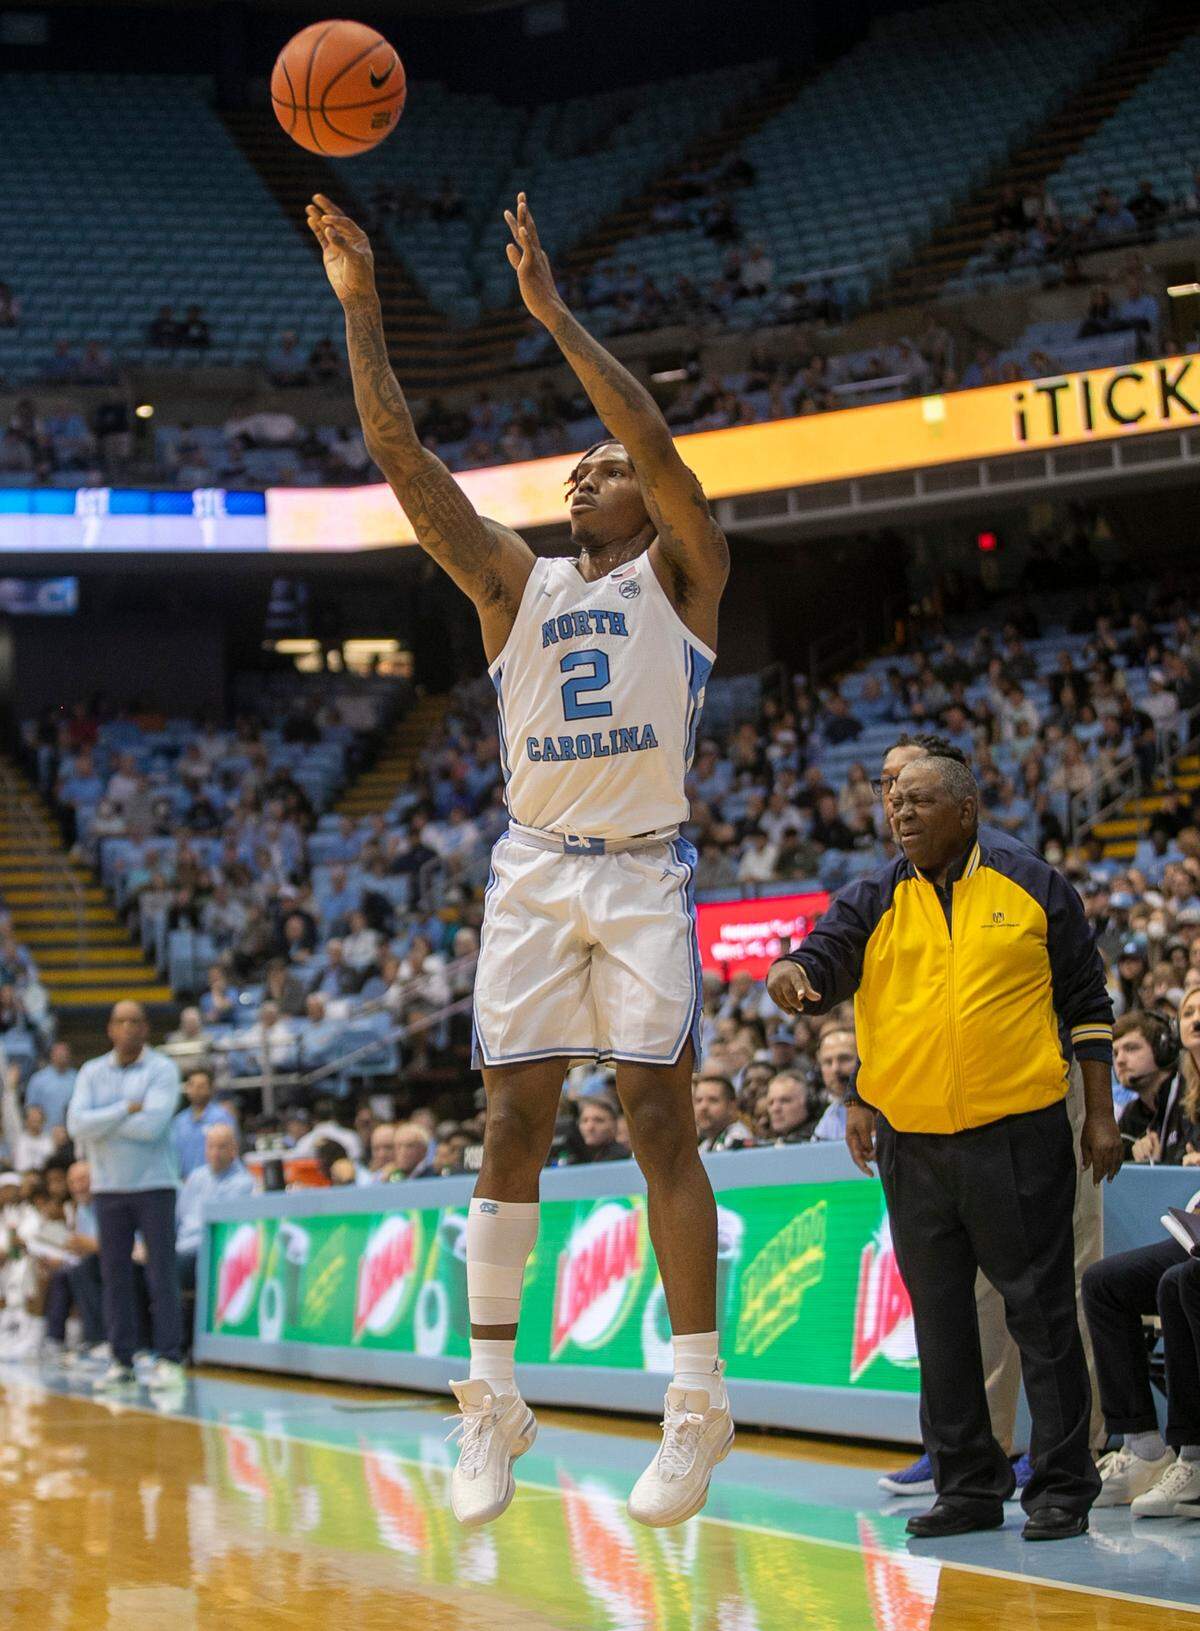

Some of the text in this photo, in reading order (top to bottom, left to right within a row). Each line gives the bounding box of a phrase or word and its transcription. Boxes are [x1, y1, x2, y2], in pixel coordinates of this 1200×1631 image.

[1015, 361, 1199, 441] iTICK
[542, 609, 629, 648] NORTH
[560, 648, 613, 722] 2
[526, 723, 659, 763] CAROLINA
